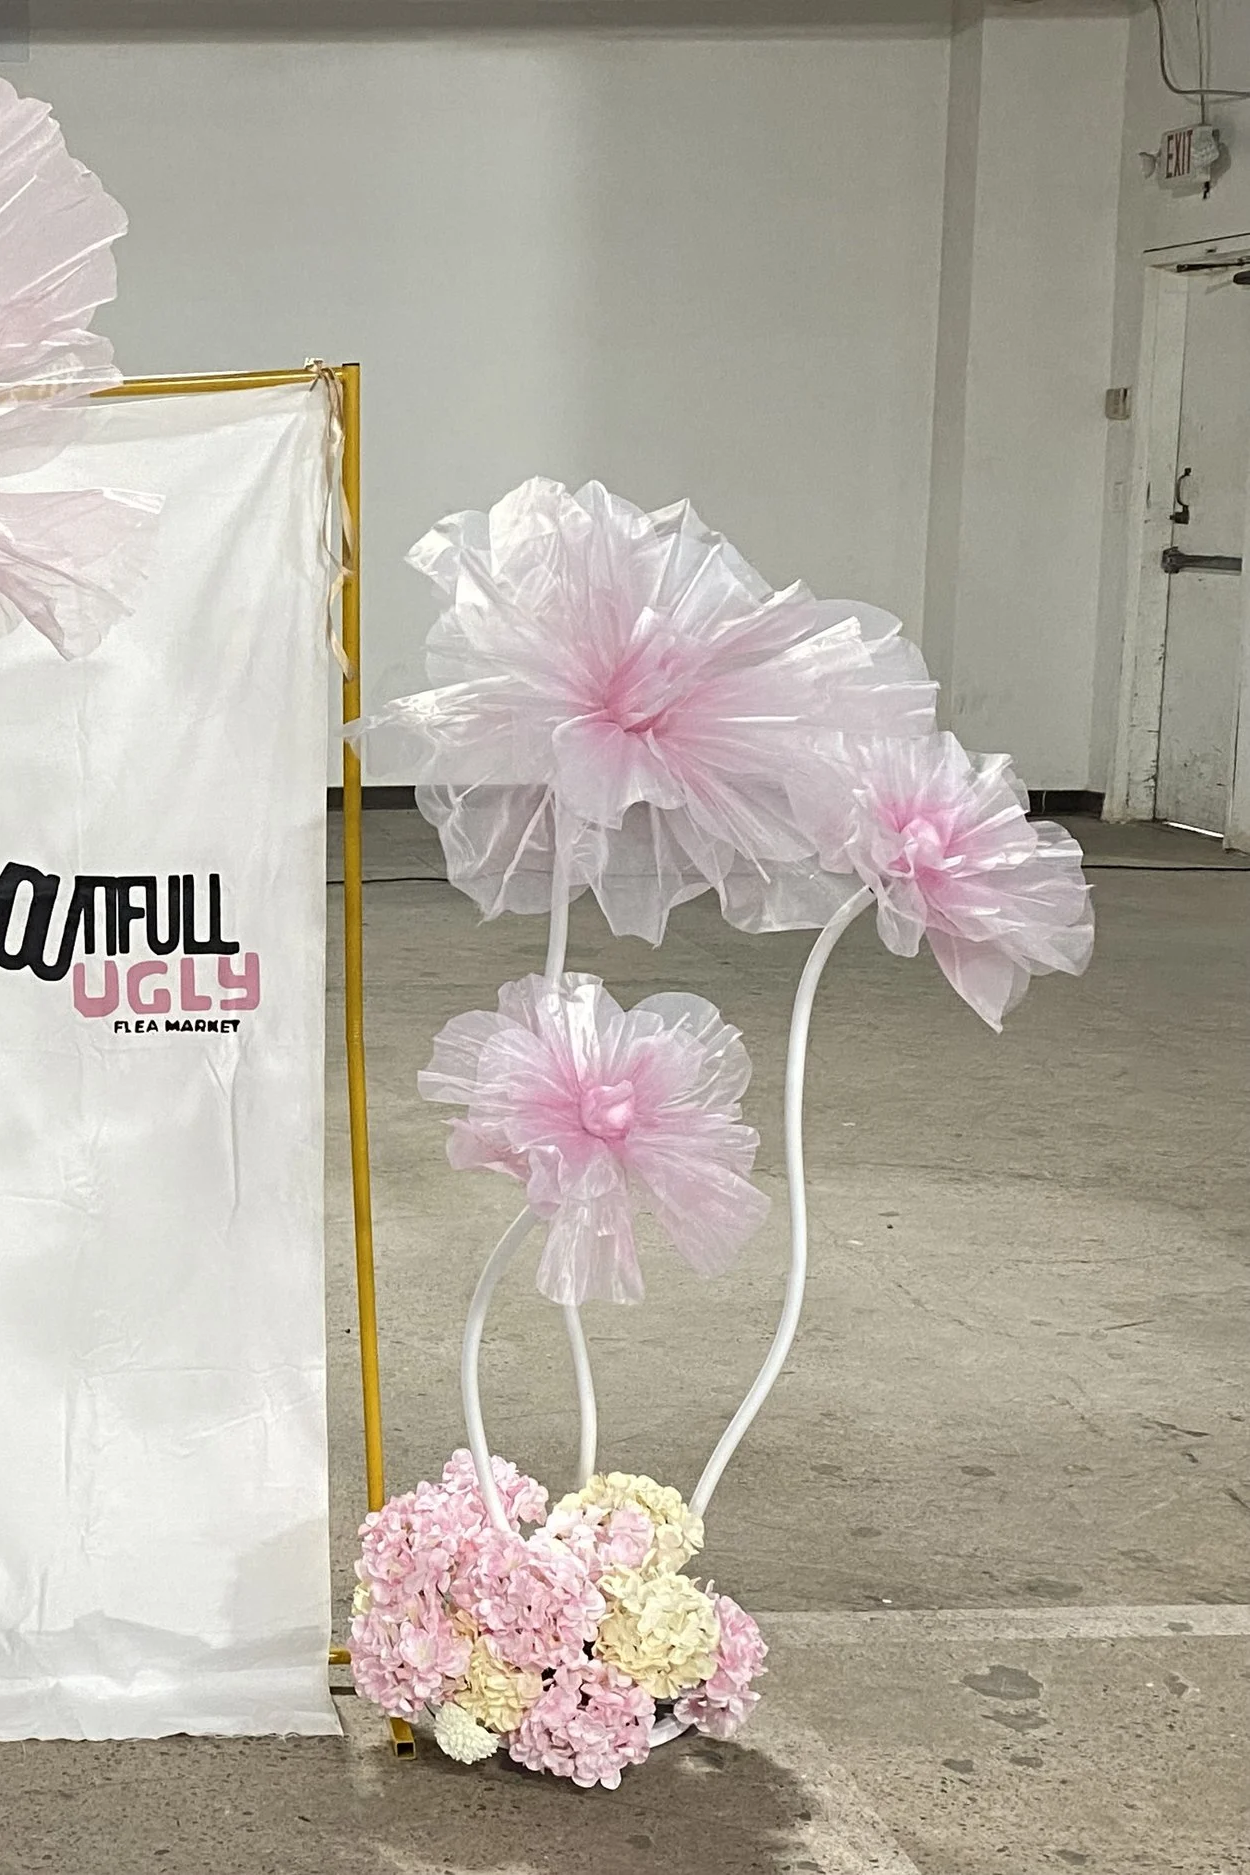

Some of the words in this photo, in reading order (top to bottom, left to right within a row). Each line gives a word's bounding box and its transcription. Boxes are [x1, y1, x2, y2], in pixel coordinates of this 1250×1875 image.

[1165, 129, 1194, 179] EXIT
[73, 952, 261, 1018] UGLY
[114, 1019, 159, 1034] FLEA
[164, 1019, 241, 1034] MARKET
